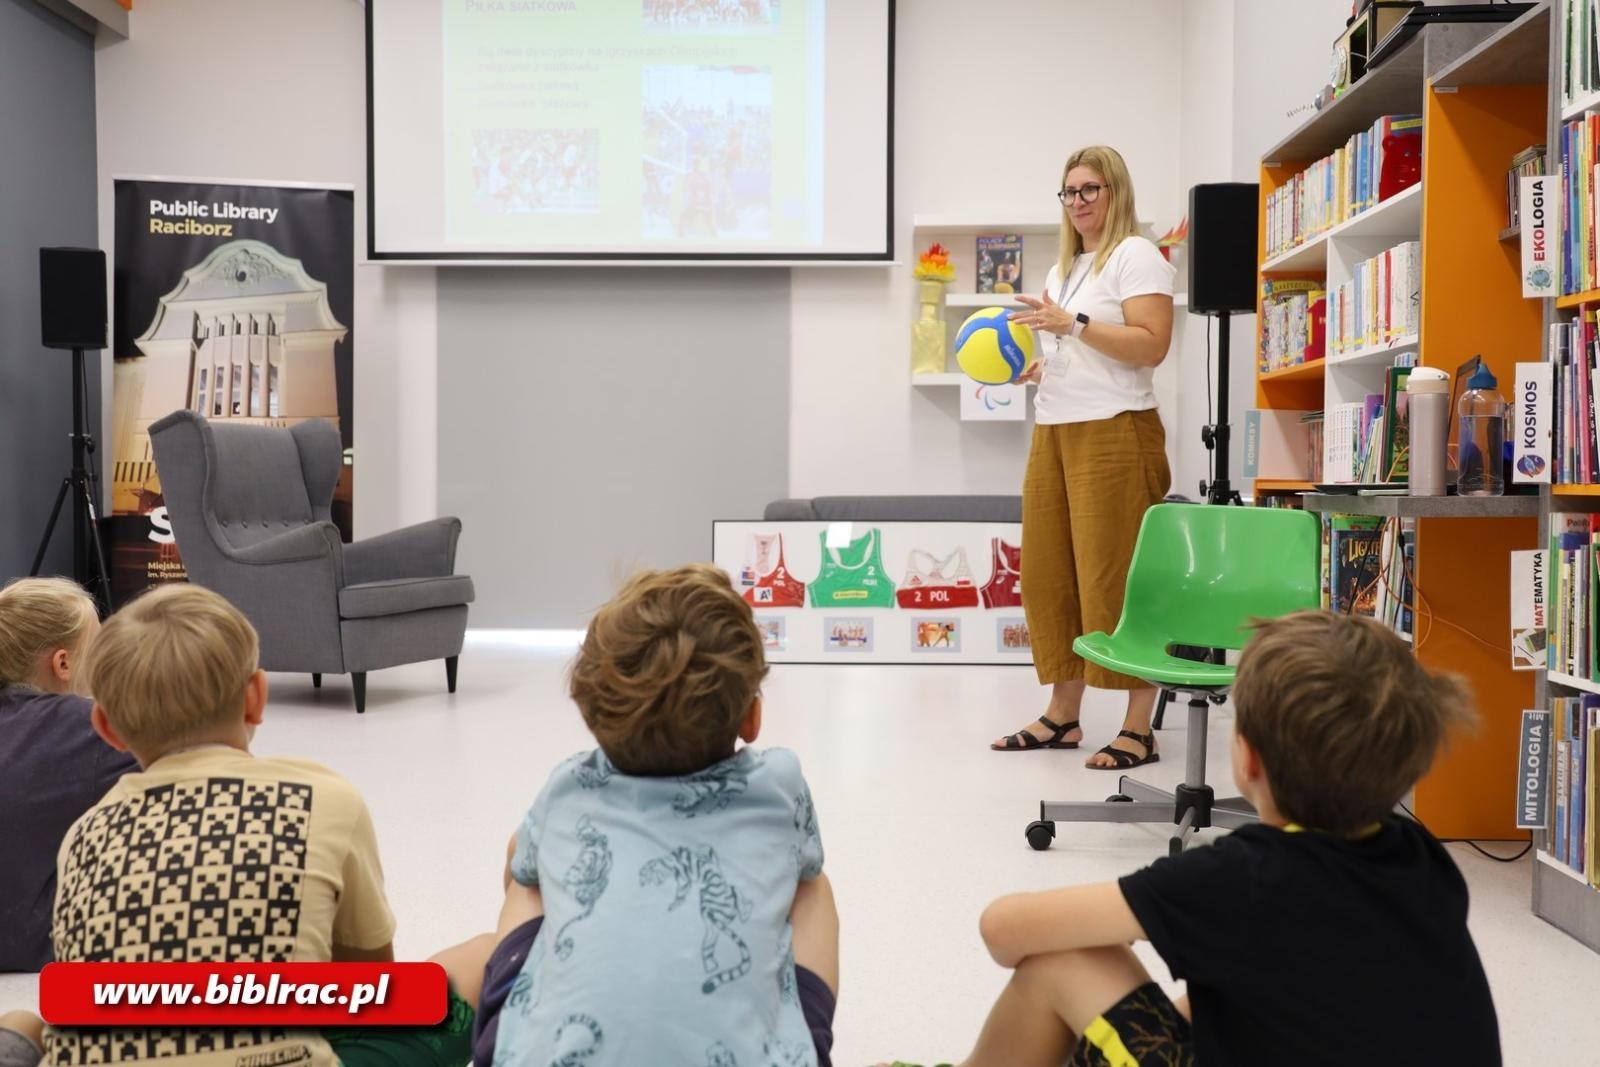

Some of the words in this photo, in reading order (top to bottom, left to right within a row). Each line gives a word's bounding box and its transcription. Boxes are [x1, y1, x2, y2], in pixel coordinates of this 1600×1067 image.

[150, 200, 209, 217] Public
[213, 202, 279, 223] Library
[1532, 180, 1545, 262] EKOLOGIA
[150, 218, 233, 237] Raciborz
[1524, 381, 1537, 449] KOSMOS
[147, 561, 181, 571] Miejska
[777, 566, 785, 579] 2
[867, 565, 875, 576] 2
[914, 591, 922, 602] 2
[929, 591, 950, 602] POL
[1534, 552, 1543, 626] MATEMATYKA
[1525, 725, 1542, 821] MITOLOGIA
